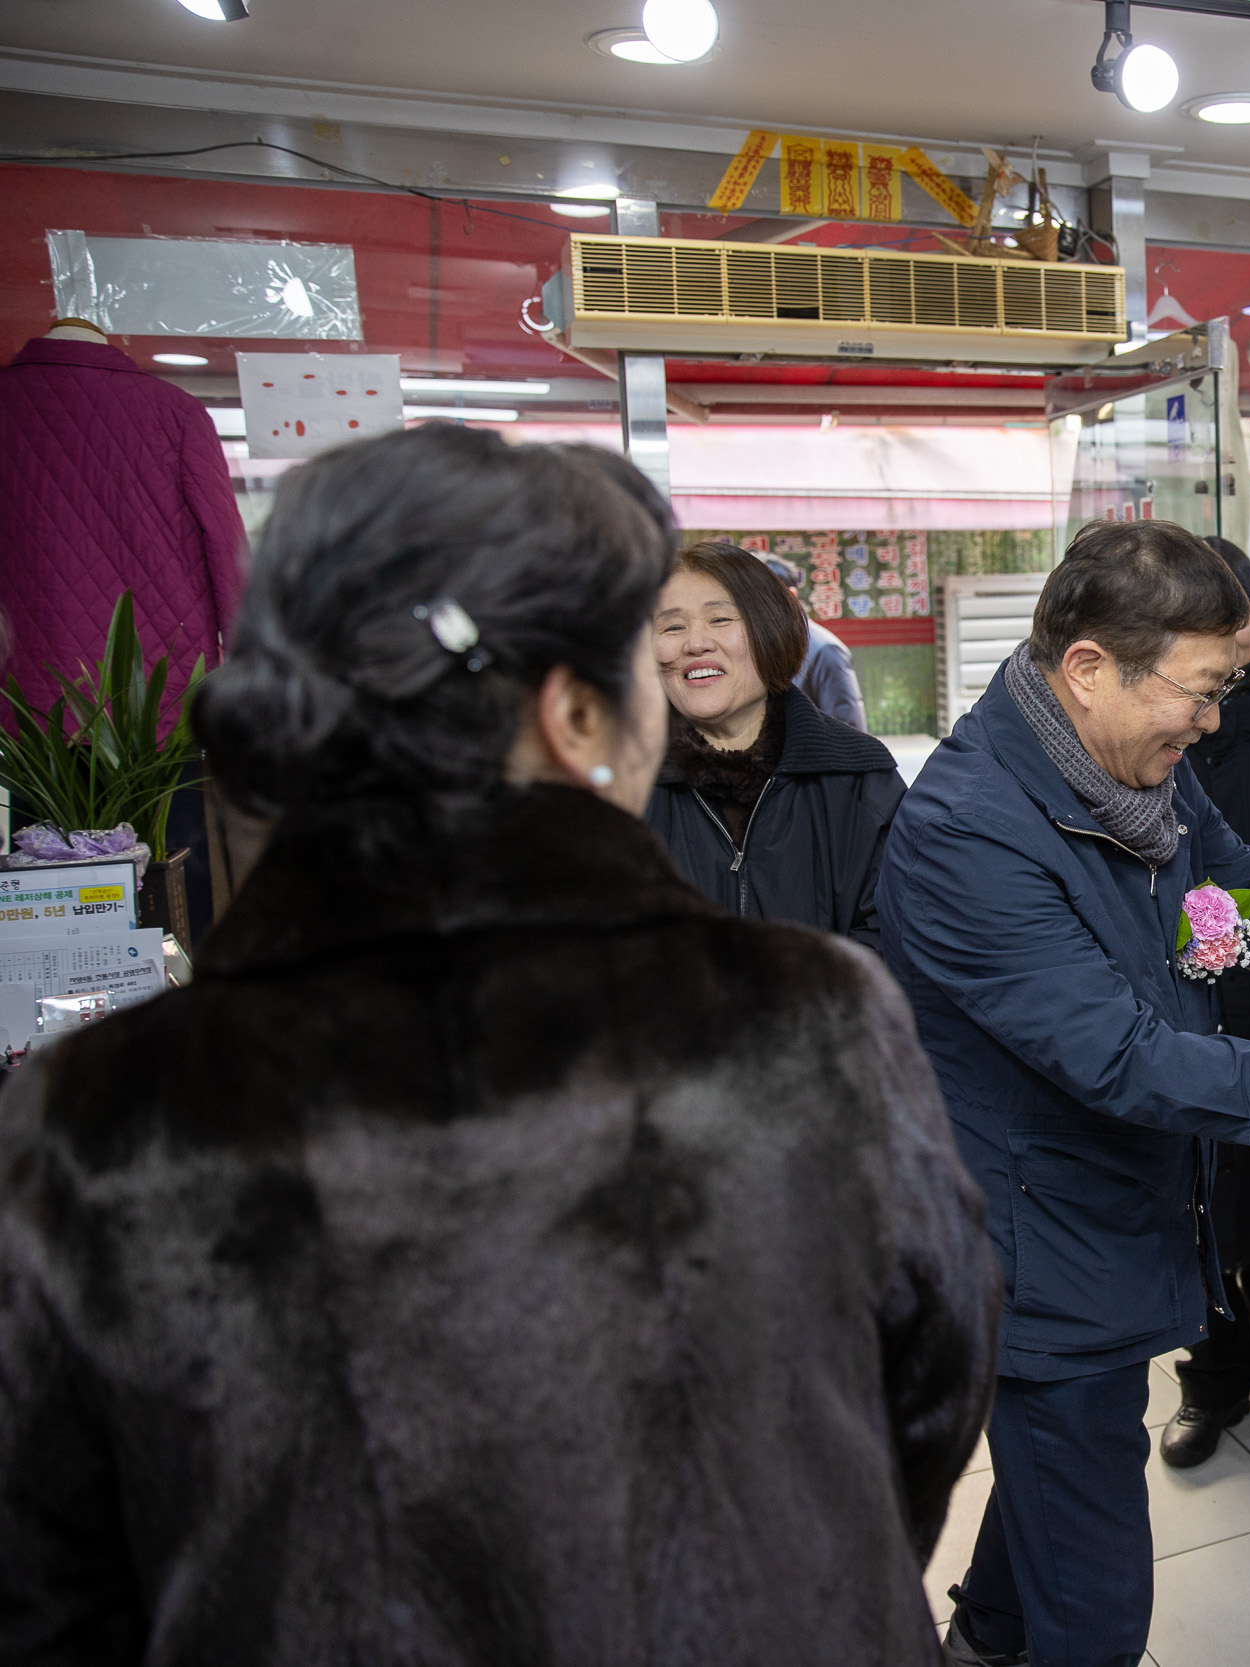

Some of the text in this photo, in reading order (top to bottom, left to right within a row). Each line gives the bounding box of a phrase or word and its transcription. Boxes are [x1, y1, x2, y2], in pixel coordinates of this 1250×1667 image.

[14, 890, 52, 903] 레저상해
[54, 890, 74, 900] 공제
[44, 904, 66, 917] 5년
